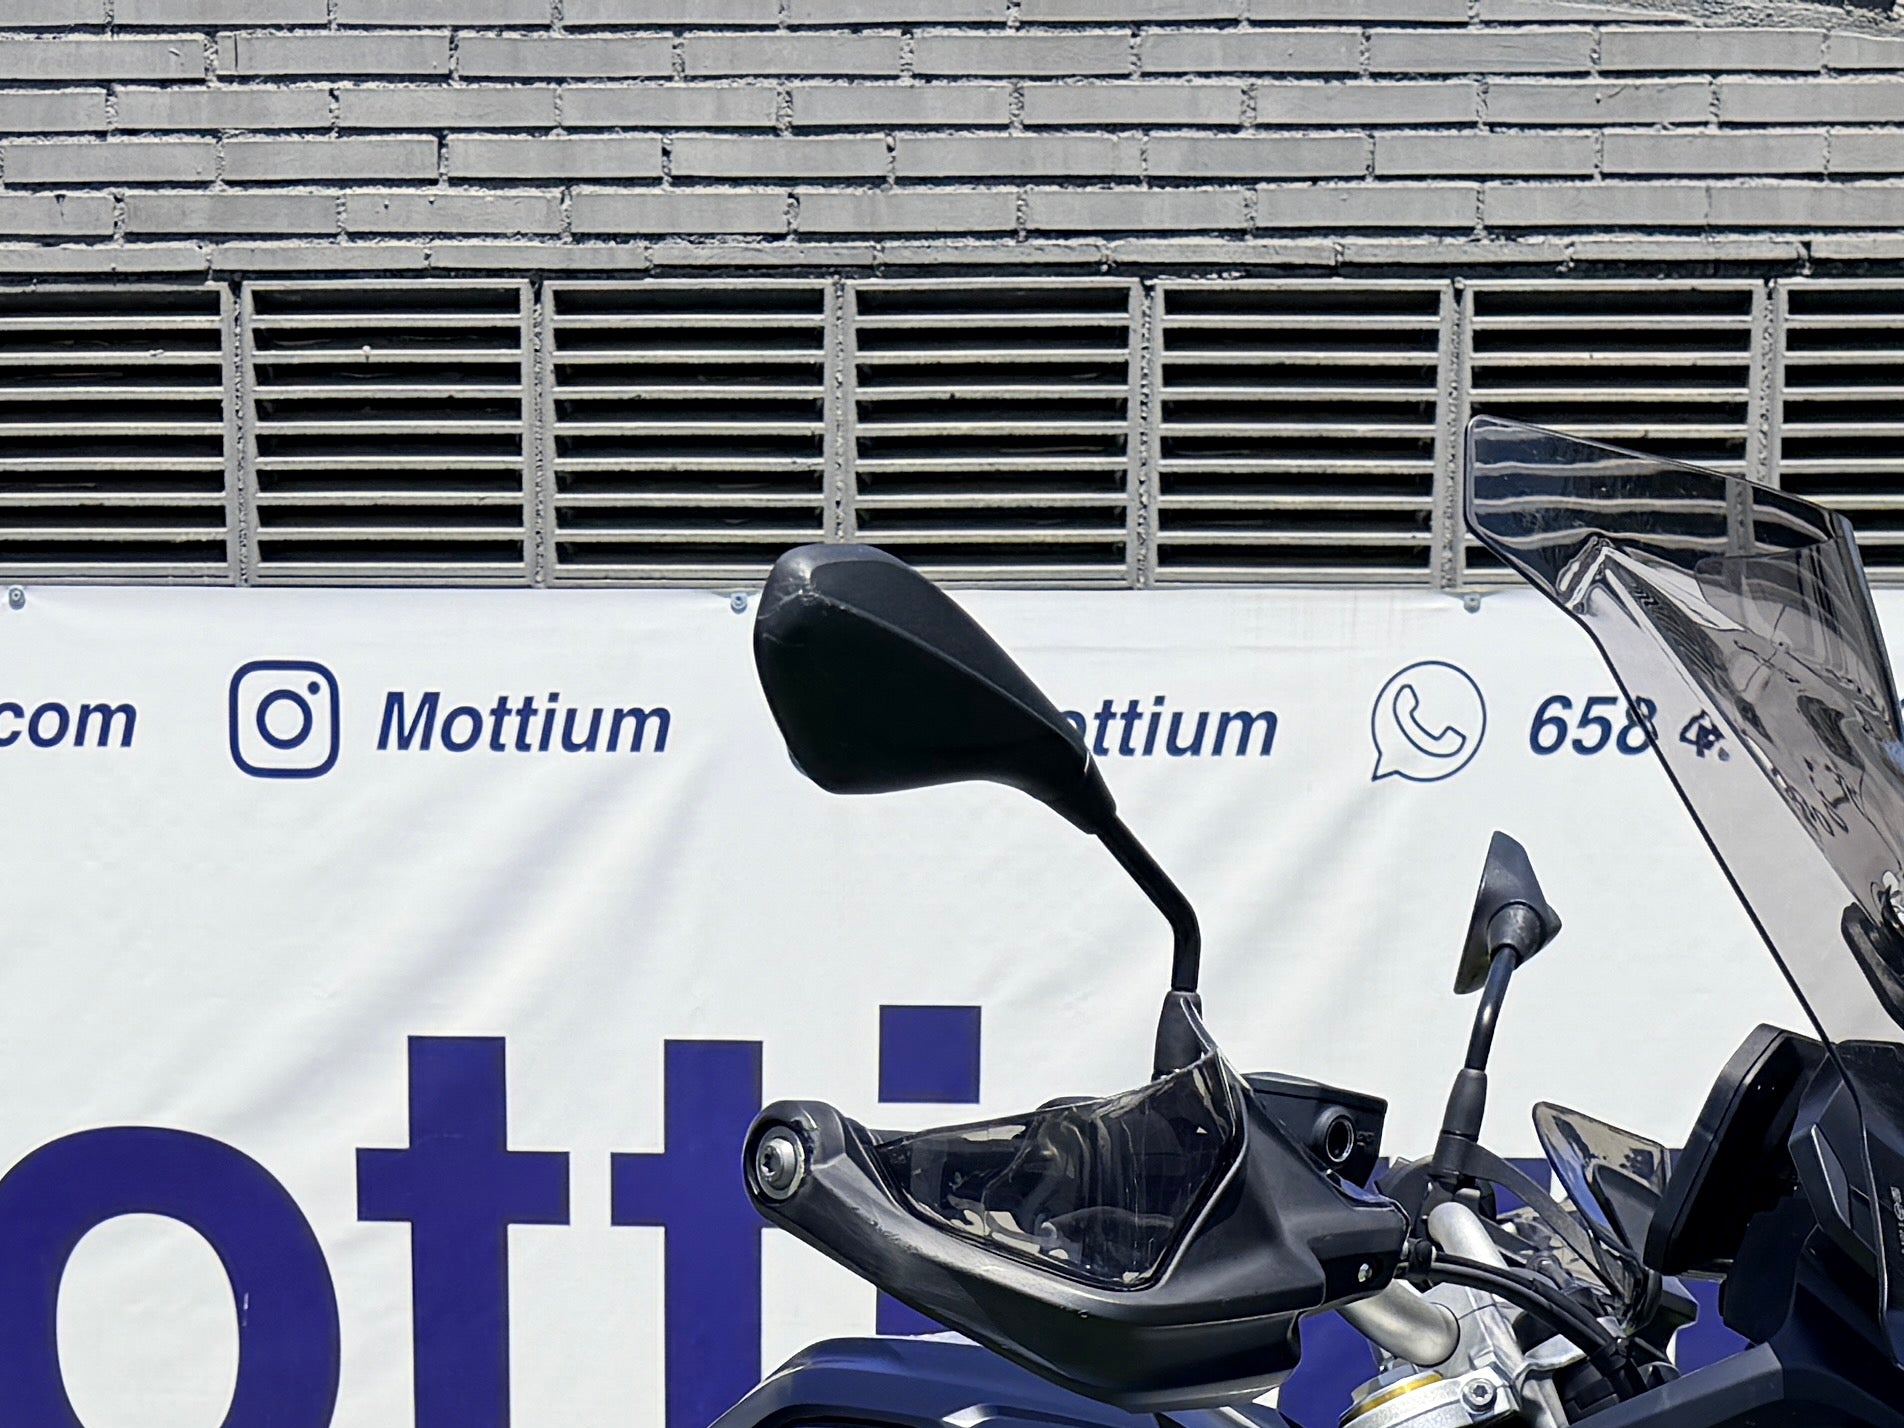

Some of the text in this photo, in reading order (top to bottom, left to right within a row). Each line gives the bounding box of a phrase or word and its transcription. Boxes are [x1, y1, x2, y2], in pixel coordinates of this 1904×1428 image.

[376, 690, 672, 754] Mottium
[1054, 695, 1279, 757] ttium
[1528, 695, 1659, 756] 658
